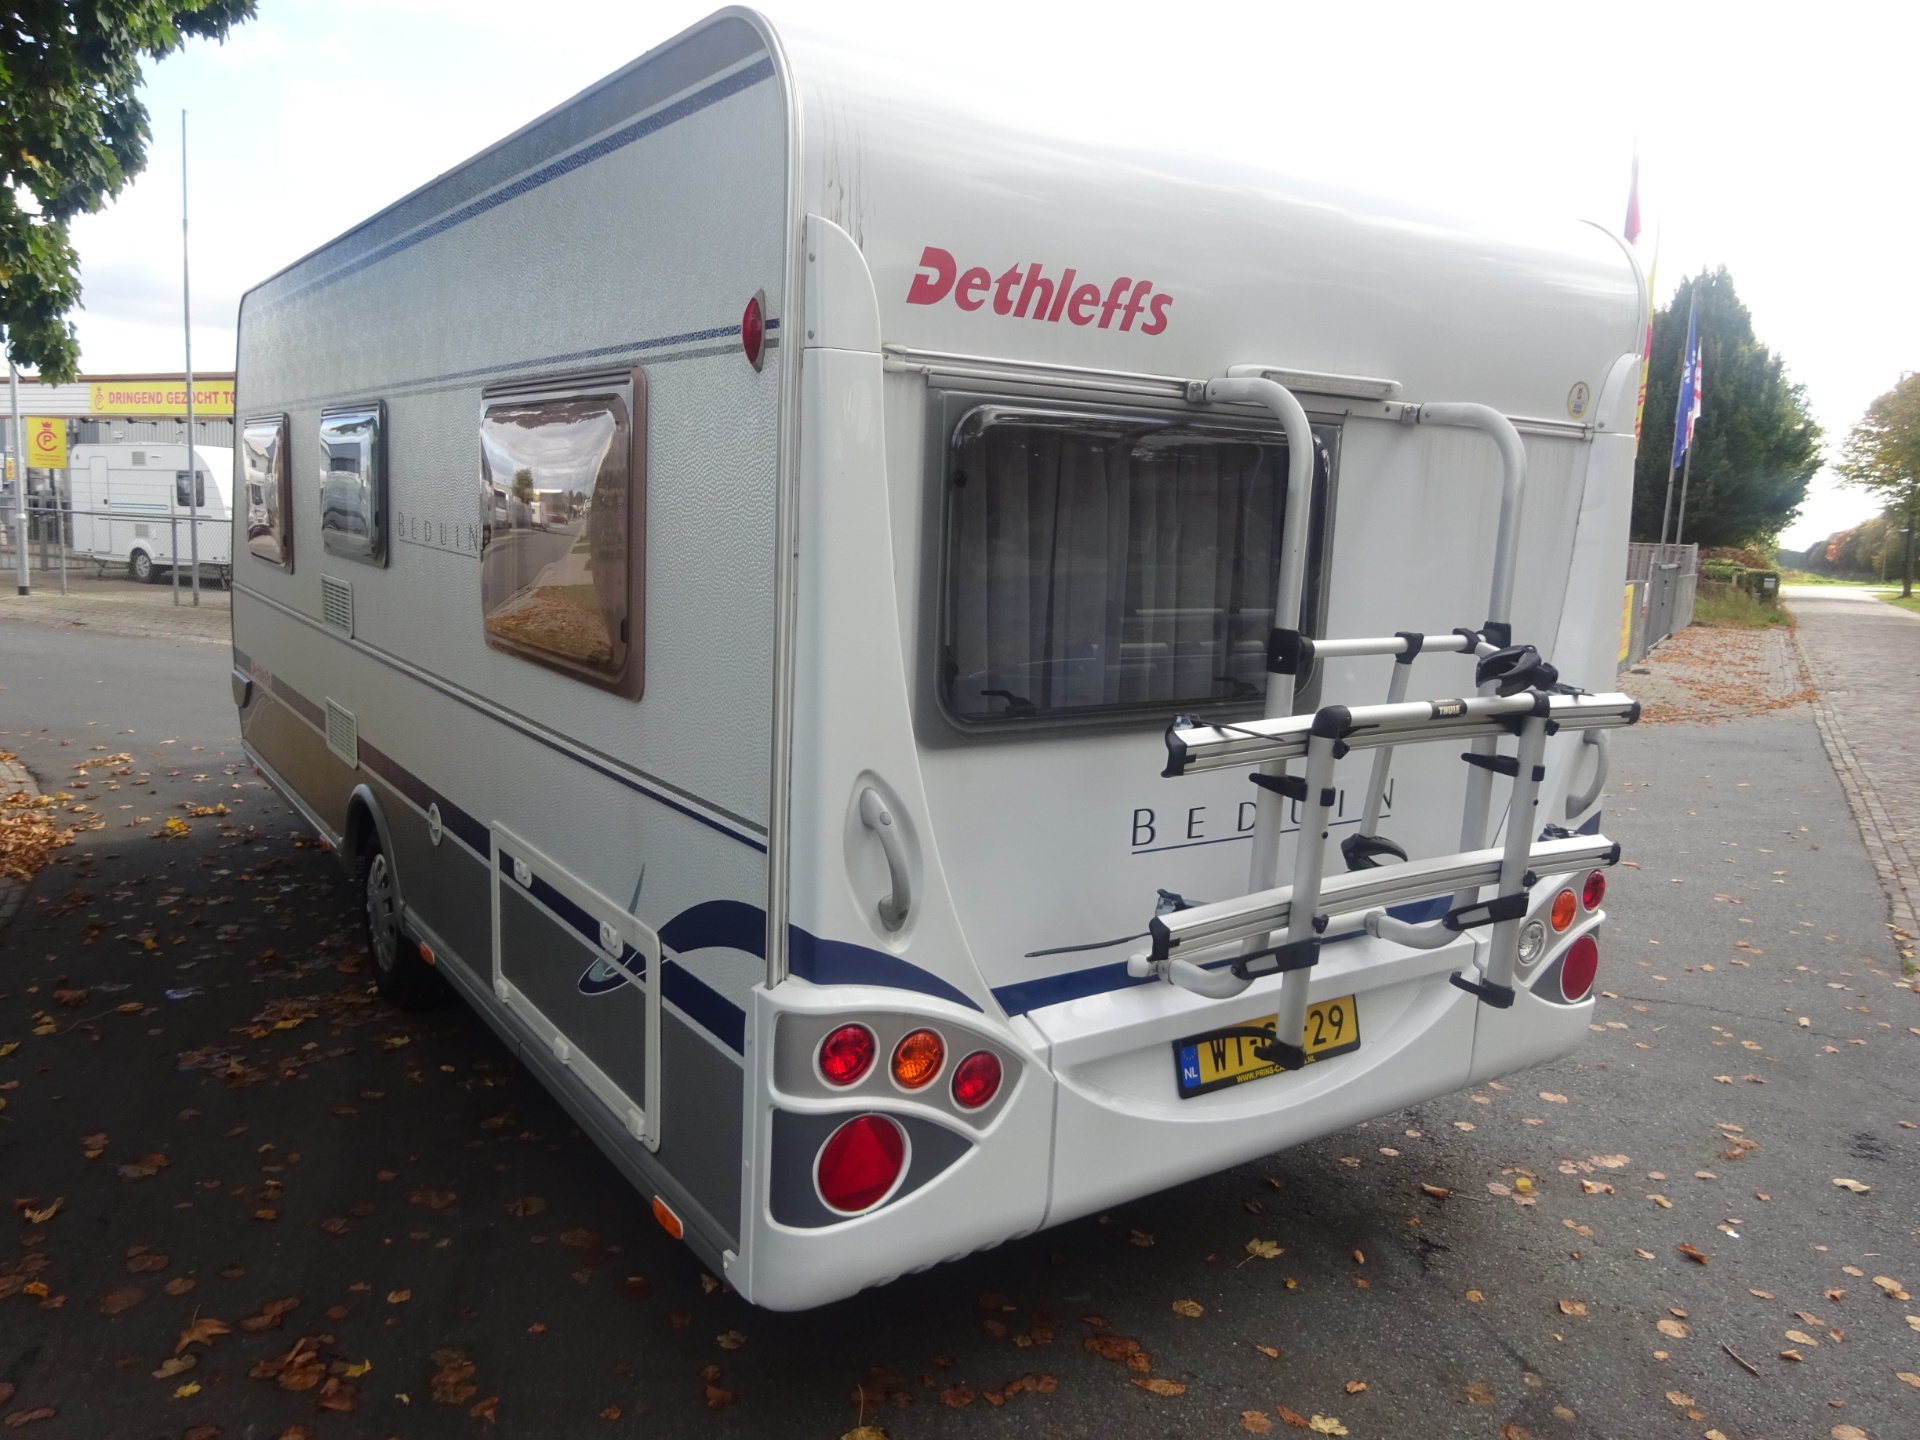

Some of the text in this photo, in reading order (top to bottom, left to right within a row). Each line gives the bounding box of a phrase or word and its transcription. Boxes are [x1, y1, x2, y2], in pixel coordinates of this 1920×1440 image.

[906, 246, 1173, 336] Dethleffs
[108, 391, 163, 404] DRINGEND
[398, 512, 478, 552] BEDUIN
[1438, 704, 1460, 716] THULE
[1184, 1067, 1198, 1081] NL
